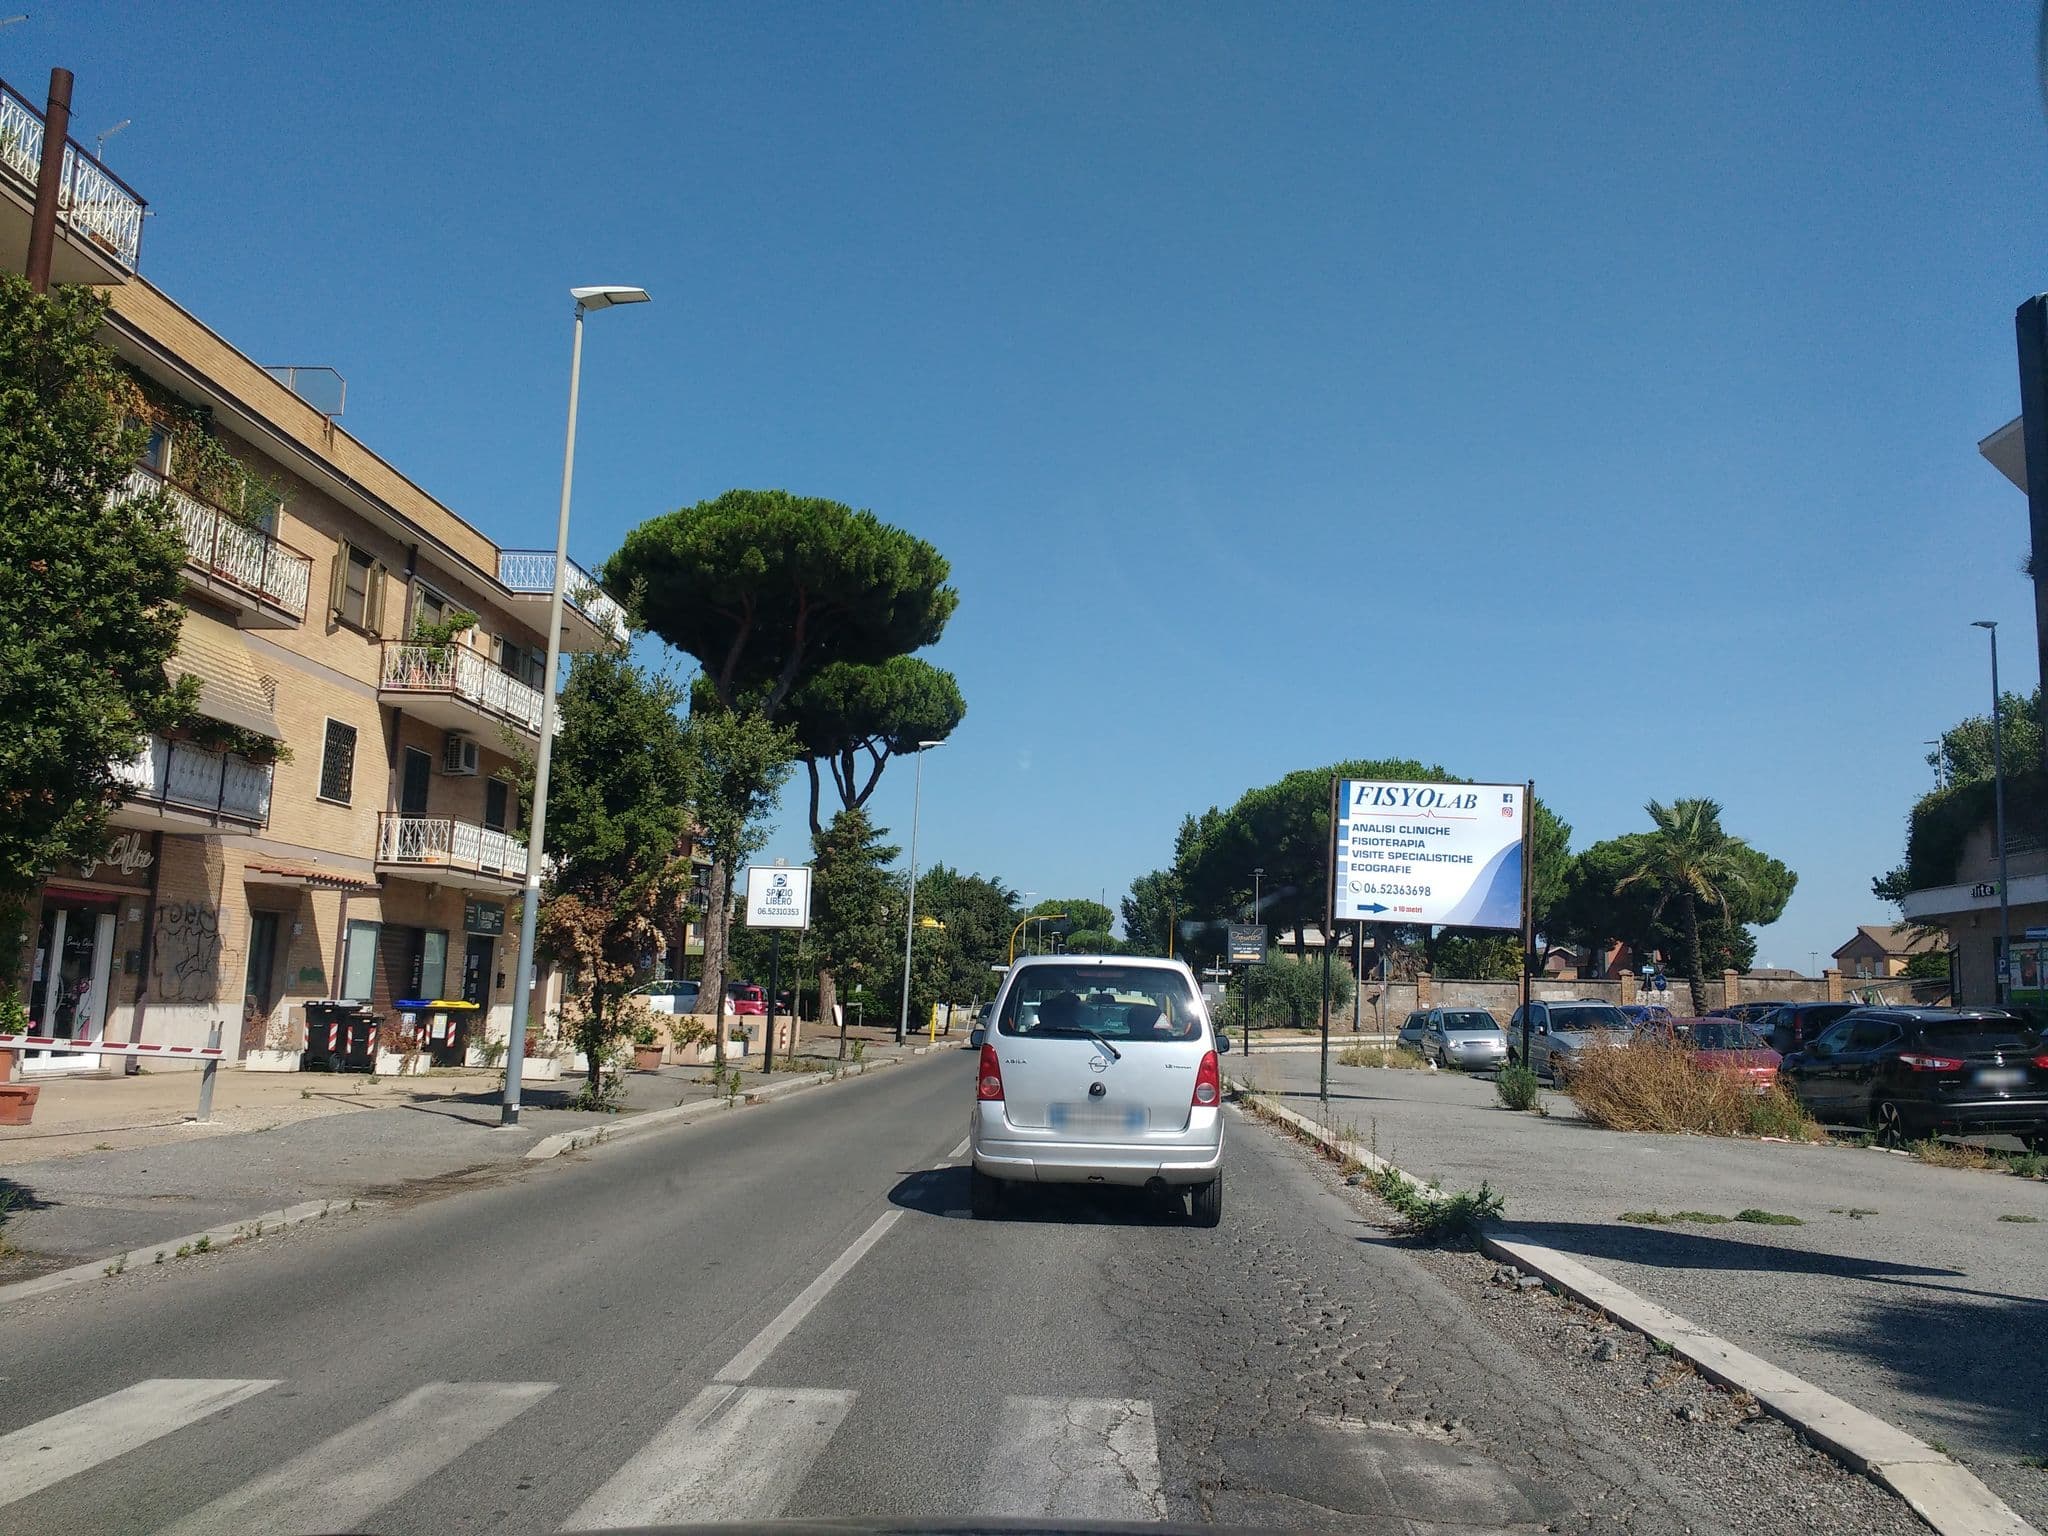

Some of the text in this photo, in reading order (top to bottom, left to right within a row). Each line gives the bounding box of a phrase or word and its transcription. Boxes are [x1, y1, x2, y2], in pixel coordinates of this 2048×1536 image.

[1354, 785, 1478, 809] FISYOLAB
[1352, 823, 1451, 836] ANALISI CLINICHE
[1352, 837, 1426, 848] FISIOTERAPIA
[1352, 850, 1473, 864] VISITE SPECIALISTICHE
[1350, 863, 1412, 874] ECOGRAFIE
[1364, 882, 1431, 896] 06.52363698
[1968, 883, 1991, 897] elite
[765, 897, 792, 906] LIBERO
